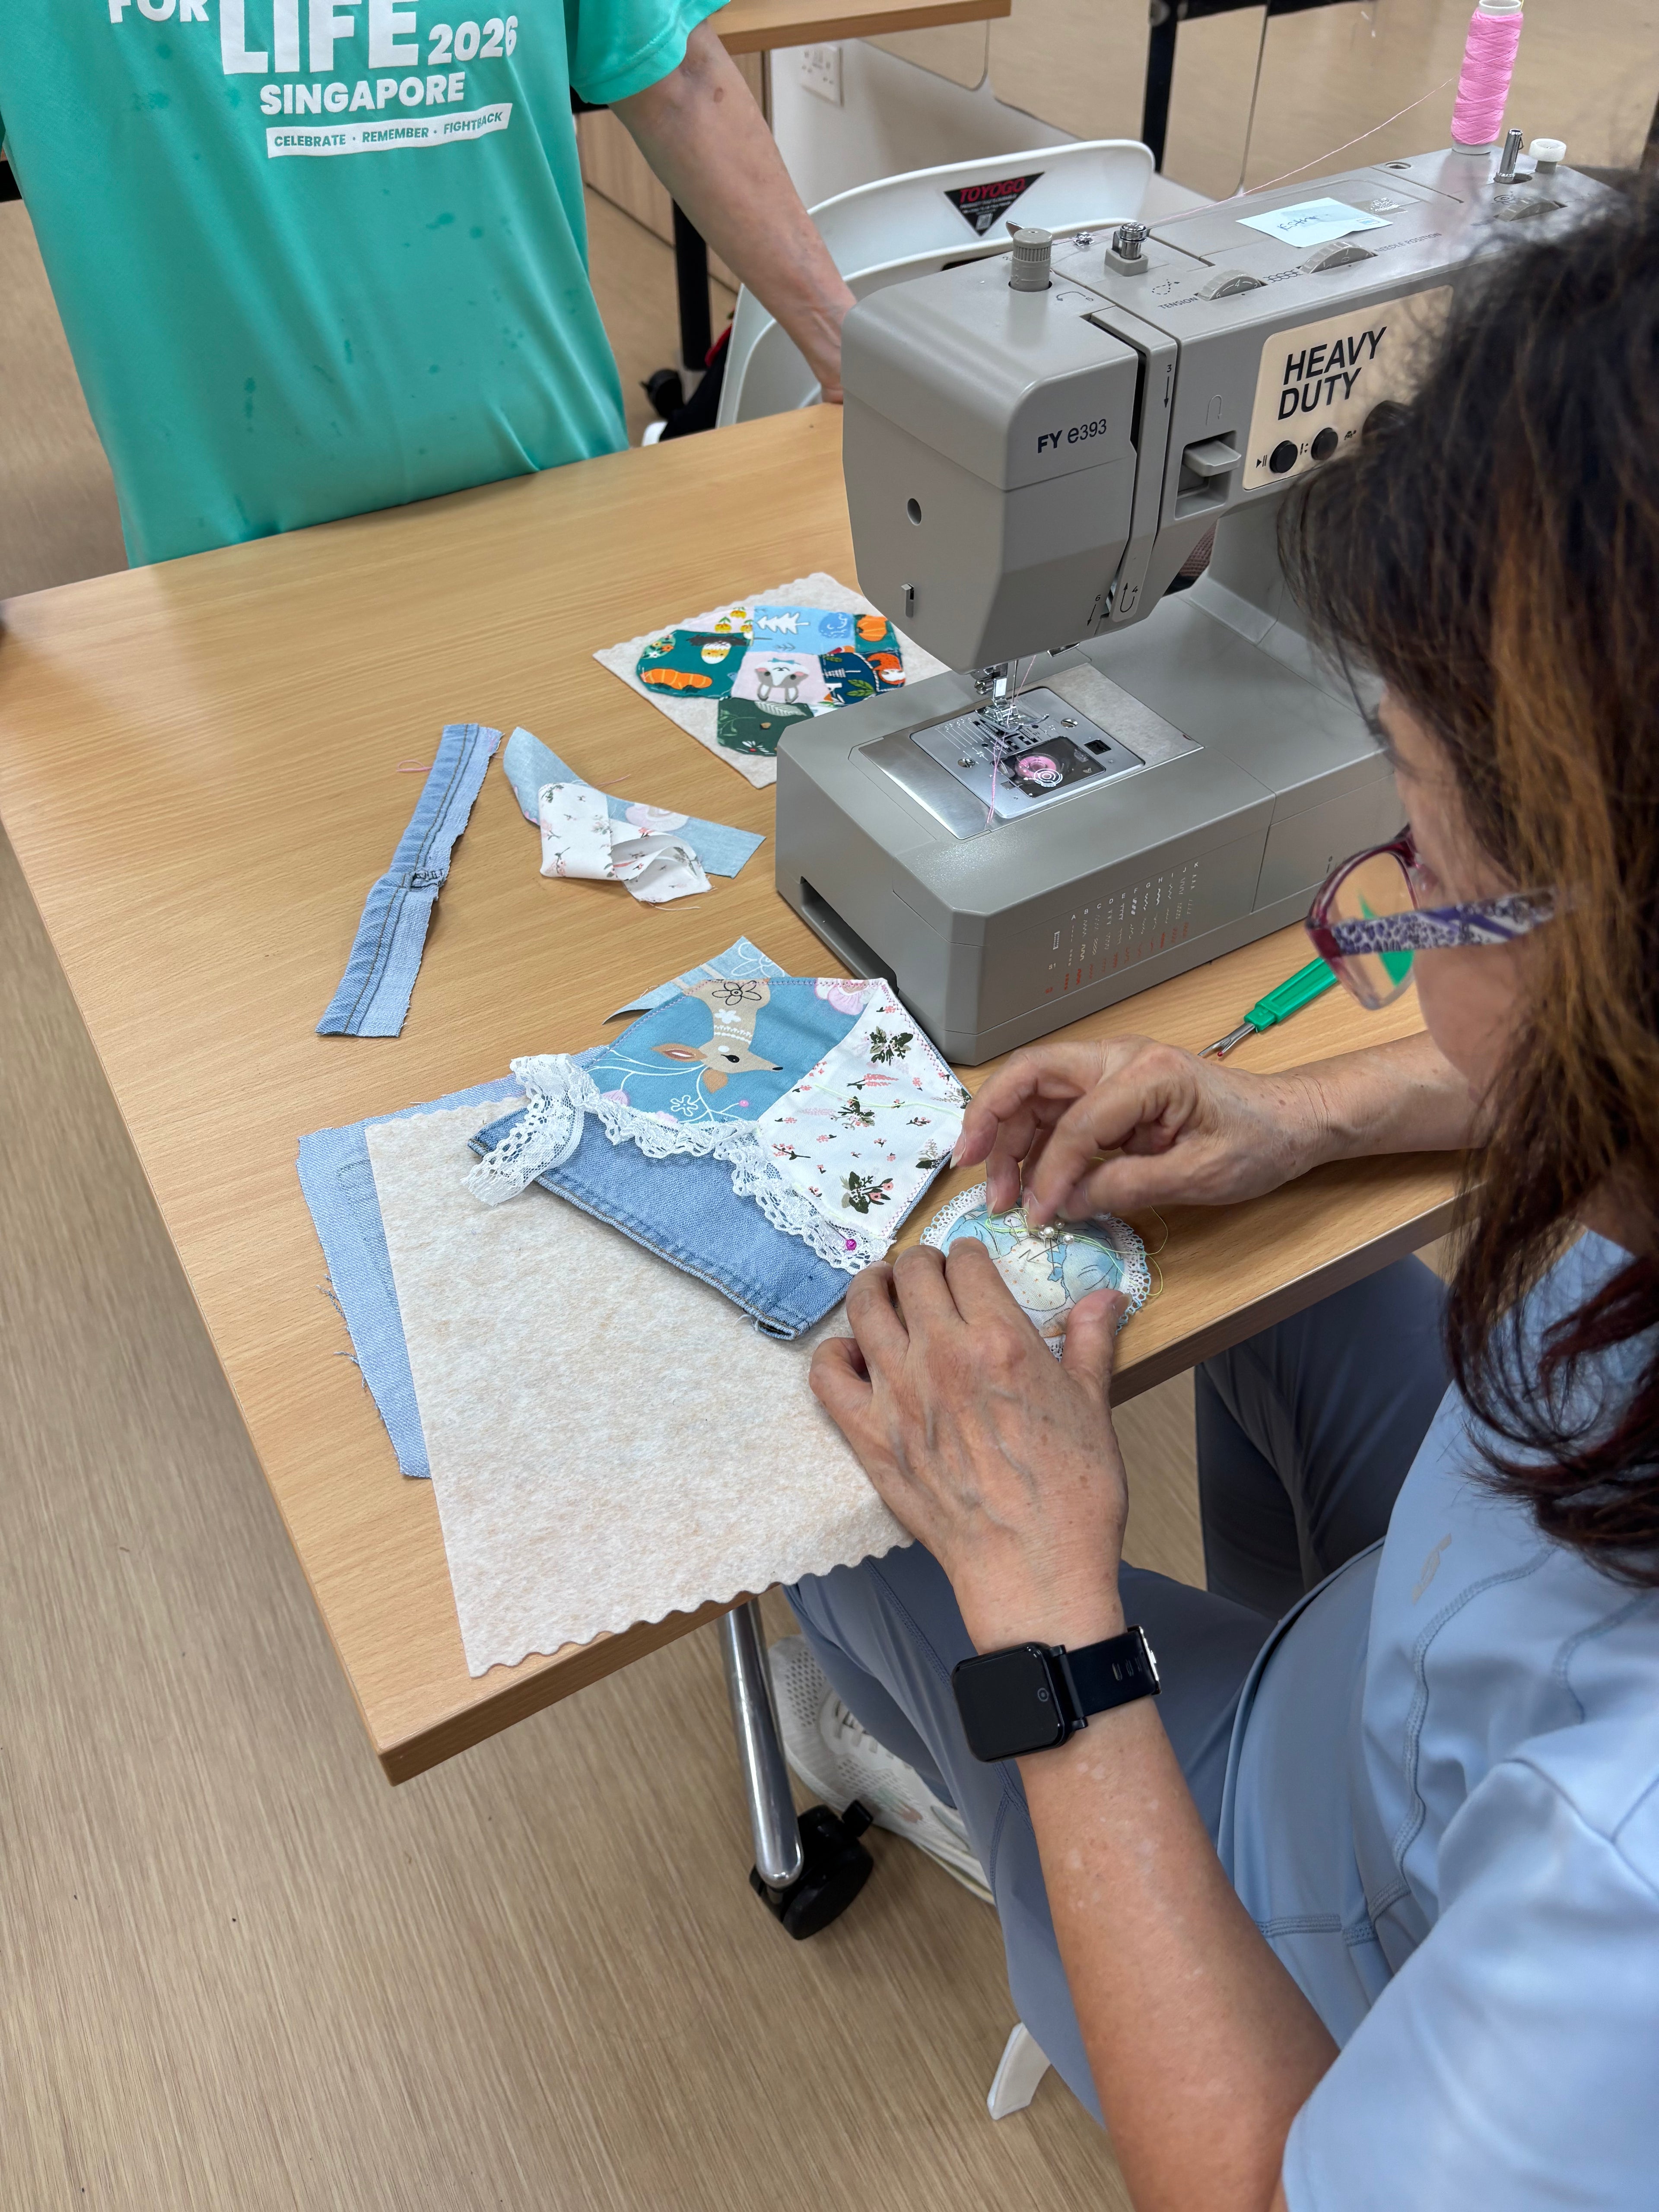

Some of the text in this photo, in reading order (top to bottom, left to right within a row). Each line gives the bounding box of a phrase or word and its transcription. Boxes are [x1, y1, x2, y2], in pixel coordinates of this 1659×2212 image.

[219, 0, 419, 74] LIFE
[428, 16, 518, 65] 2026
[260, 72, 465, 115] SINGAPORE
[274, 111, 503, 147] CELEBRATE REMEMBER FIGHTBACK
[959, 177, 1027, 204] TOYOGO
[1374, 232, 1443, 252] NEEDLE POSITION
[1235, 279, 1241, 288] 4
[1157, 296, 1199, 309] TENSION
[1167, 364, 1172, 372] 3
[1283, 326, 1387, 386] HEAVY
[1278, 367, 1362, 421] DUTY
[1037, 419, 1107, 454] FY e393
